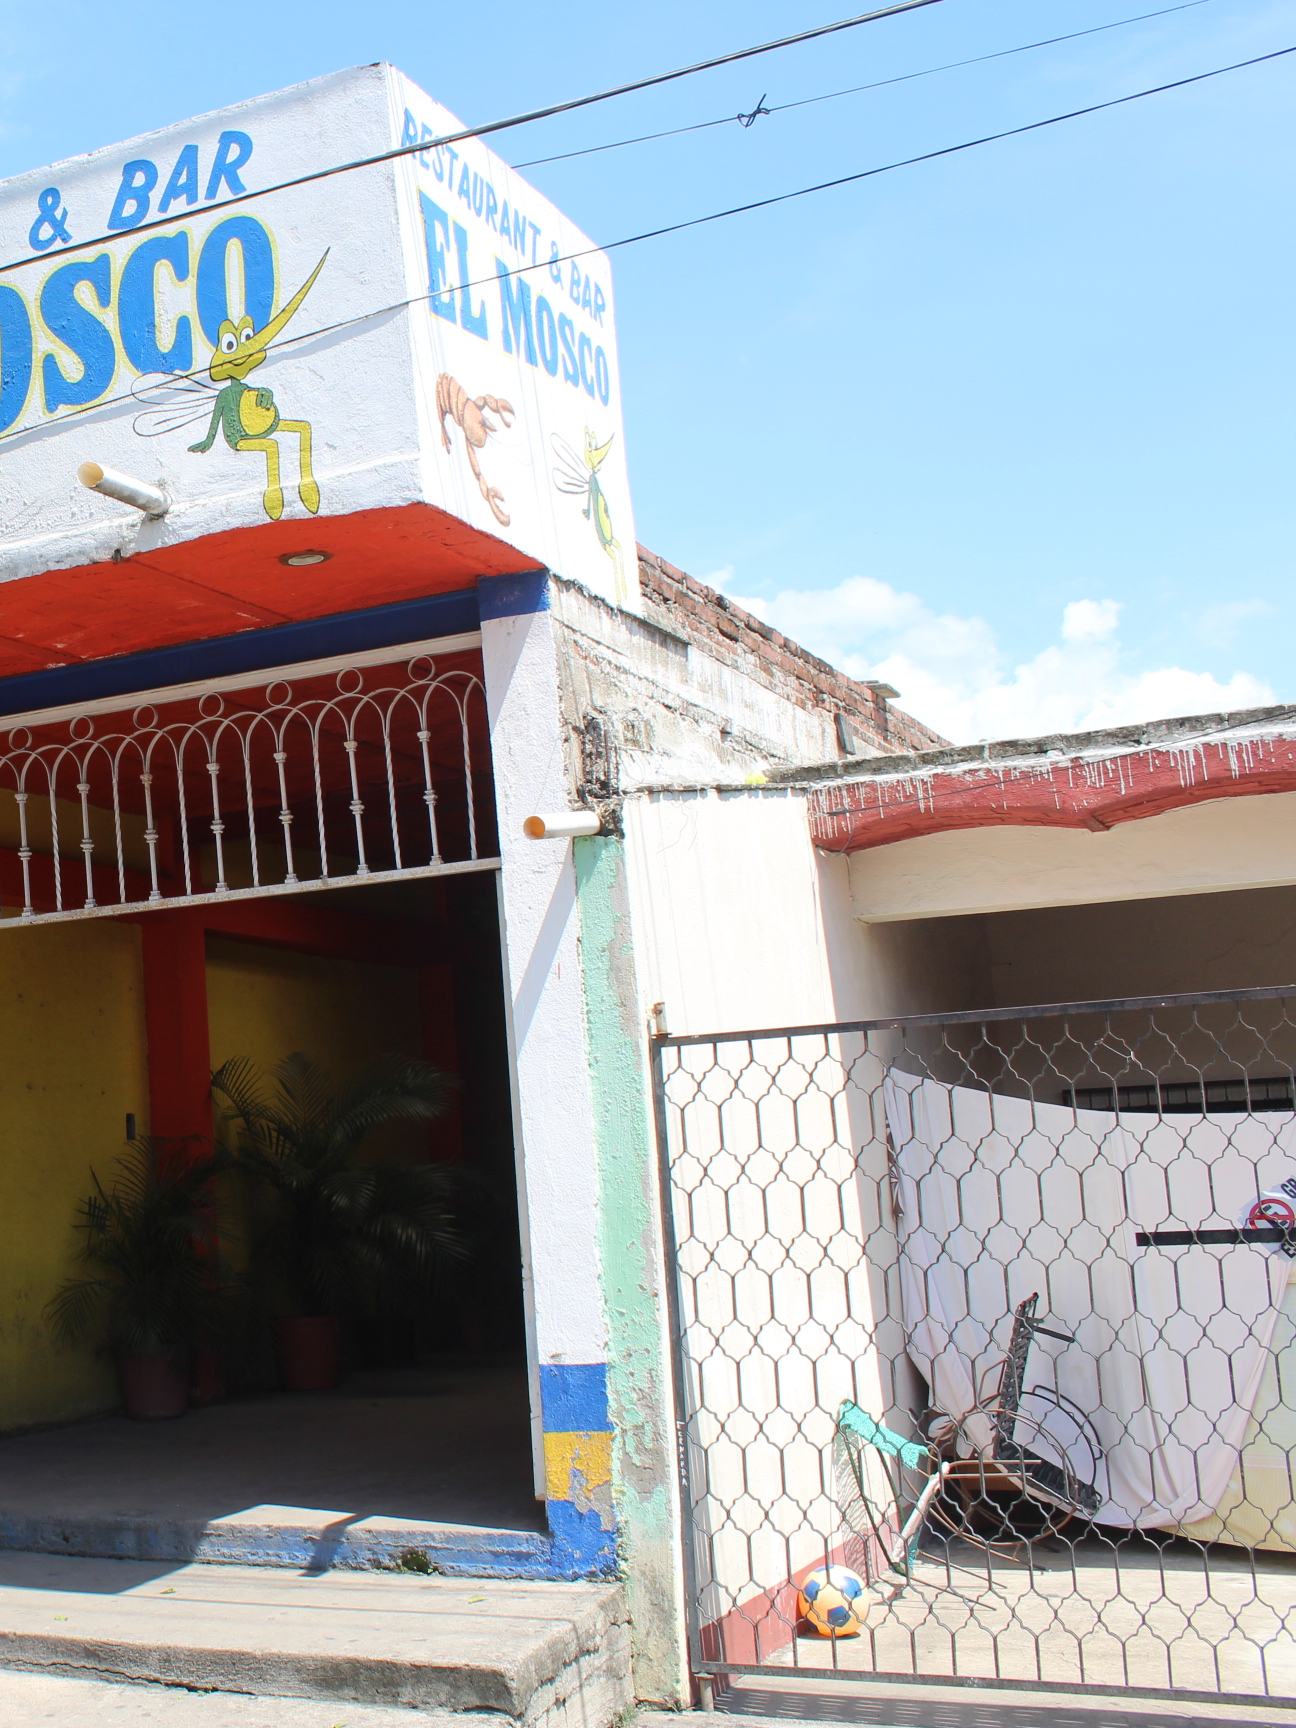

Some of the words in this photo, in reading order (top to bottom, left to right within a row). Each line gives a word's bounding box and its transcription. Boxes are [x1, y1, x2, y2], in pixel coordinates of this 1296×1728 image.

[29, 187, 73, 252] &
[107, 130, 253, 231] BAR
[401, 107, 542, 266] RESTAURANT
[549, 240, 564, 290] &
[570, 258, 606, 328] BAR
[418, 186, 489, 343] EL
[494, 254, 610, 407] MOSCO
